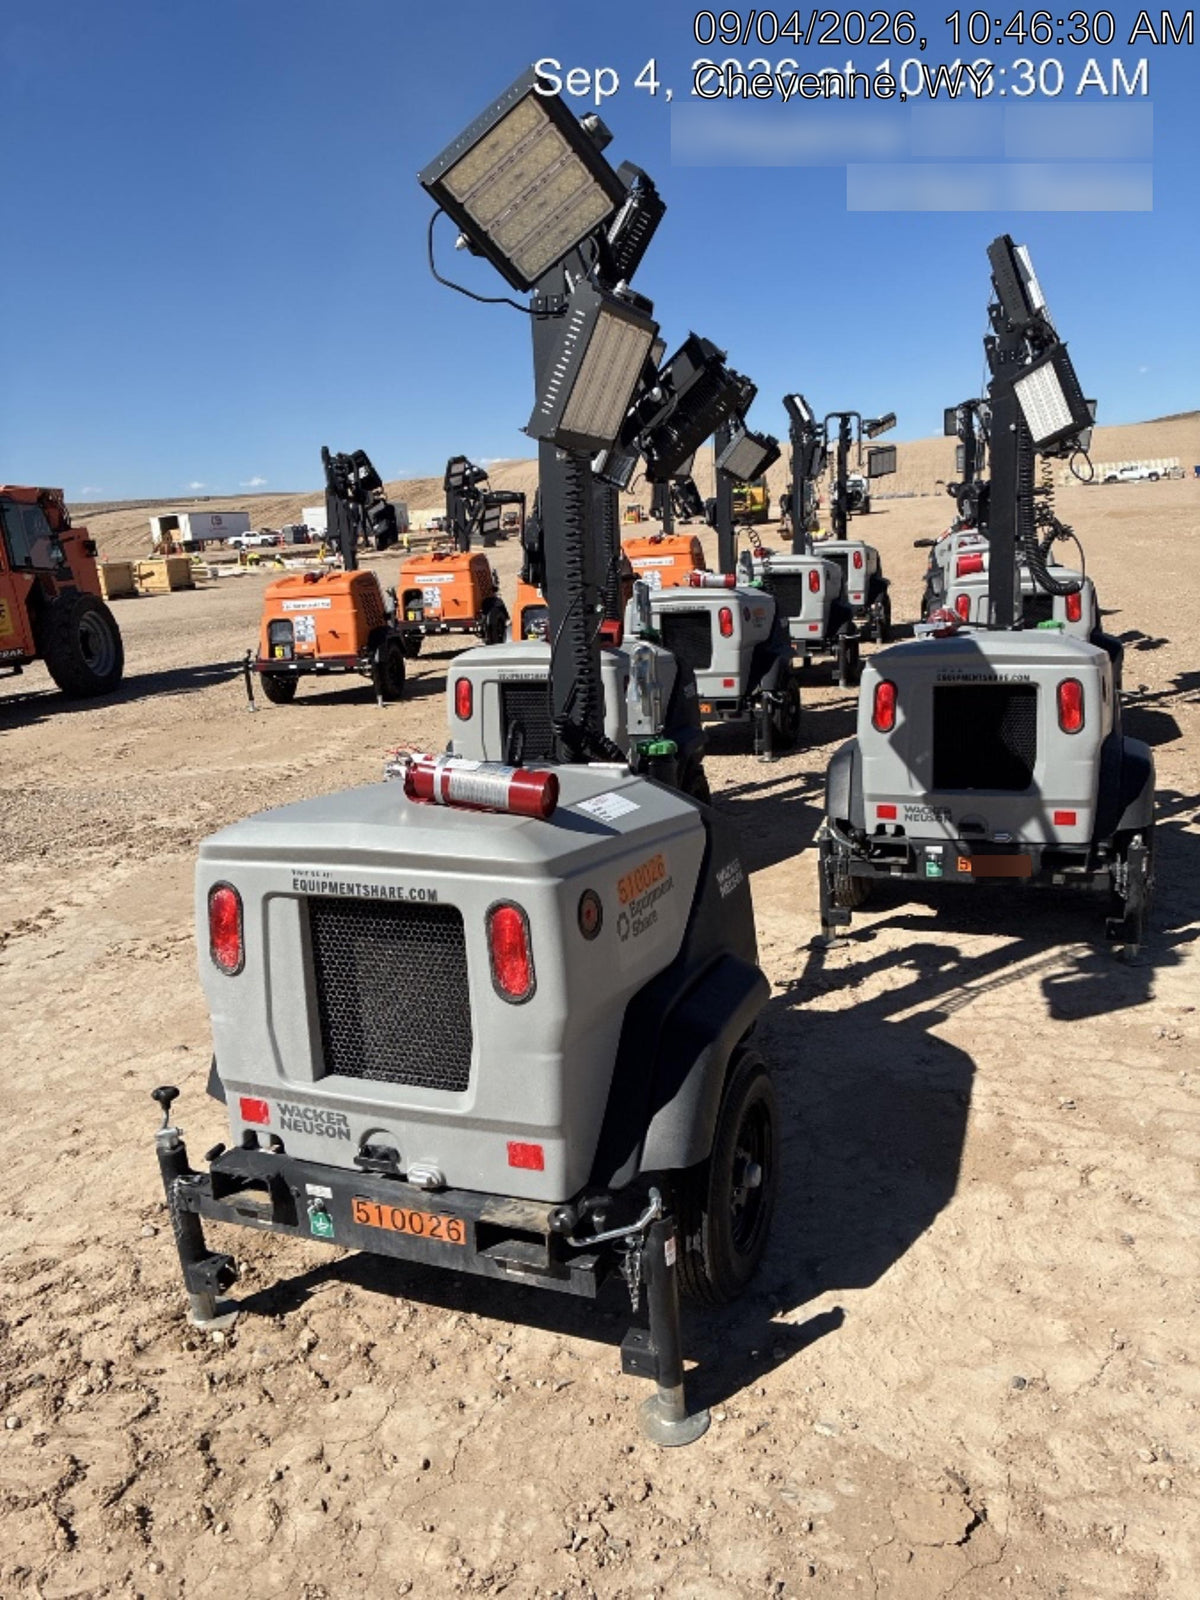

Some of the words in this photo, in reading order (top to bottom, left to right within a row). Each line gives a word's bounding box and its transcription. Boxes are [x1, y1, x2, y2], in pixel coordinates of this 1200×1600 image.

[292, 878, 438, 902] EQUIPMENTSHARE.COM
[277, 1103, 350, 1127] WACKER
[279, 1117, 350, 1141] NEUSON
[355, 1201, 462, 1242] 510026
